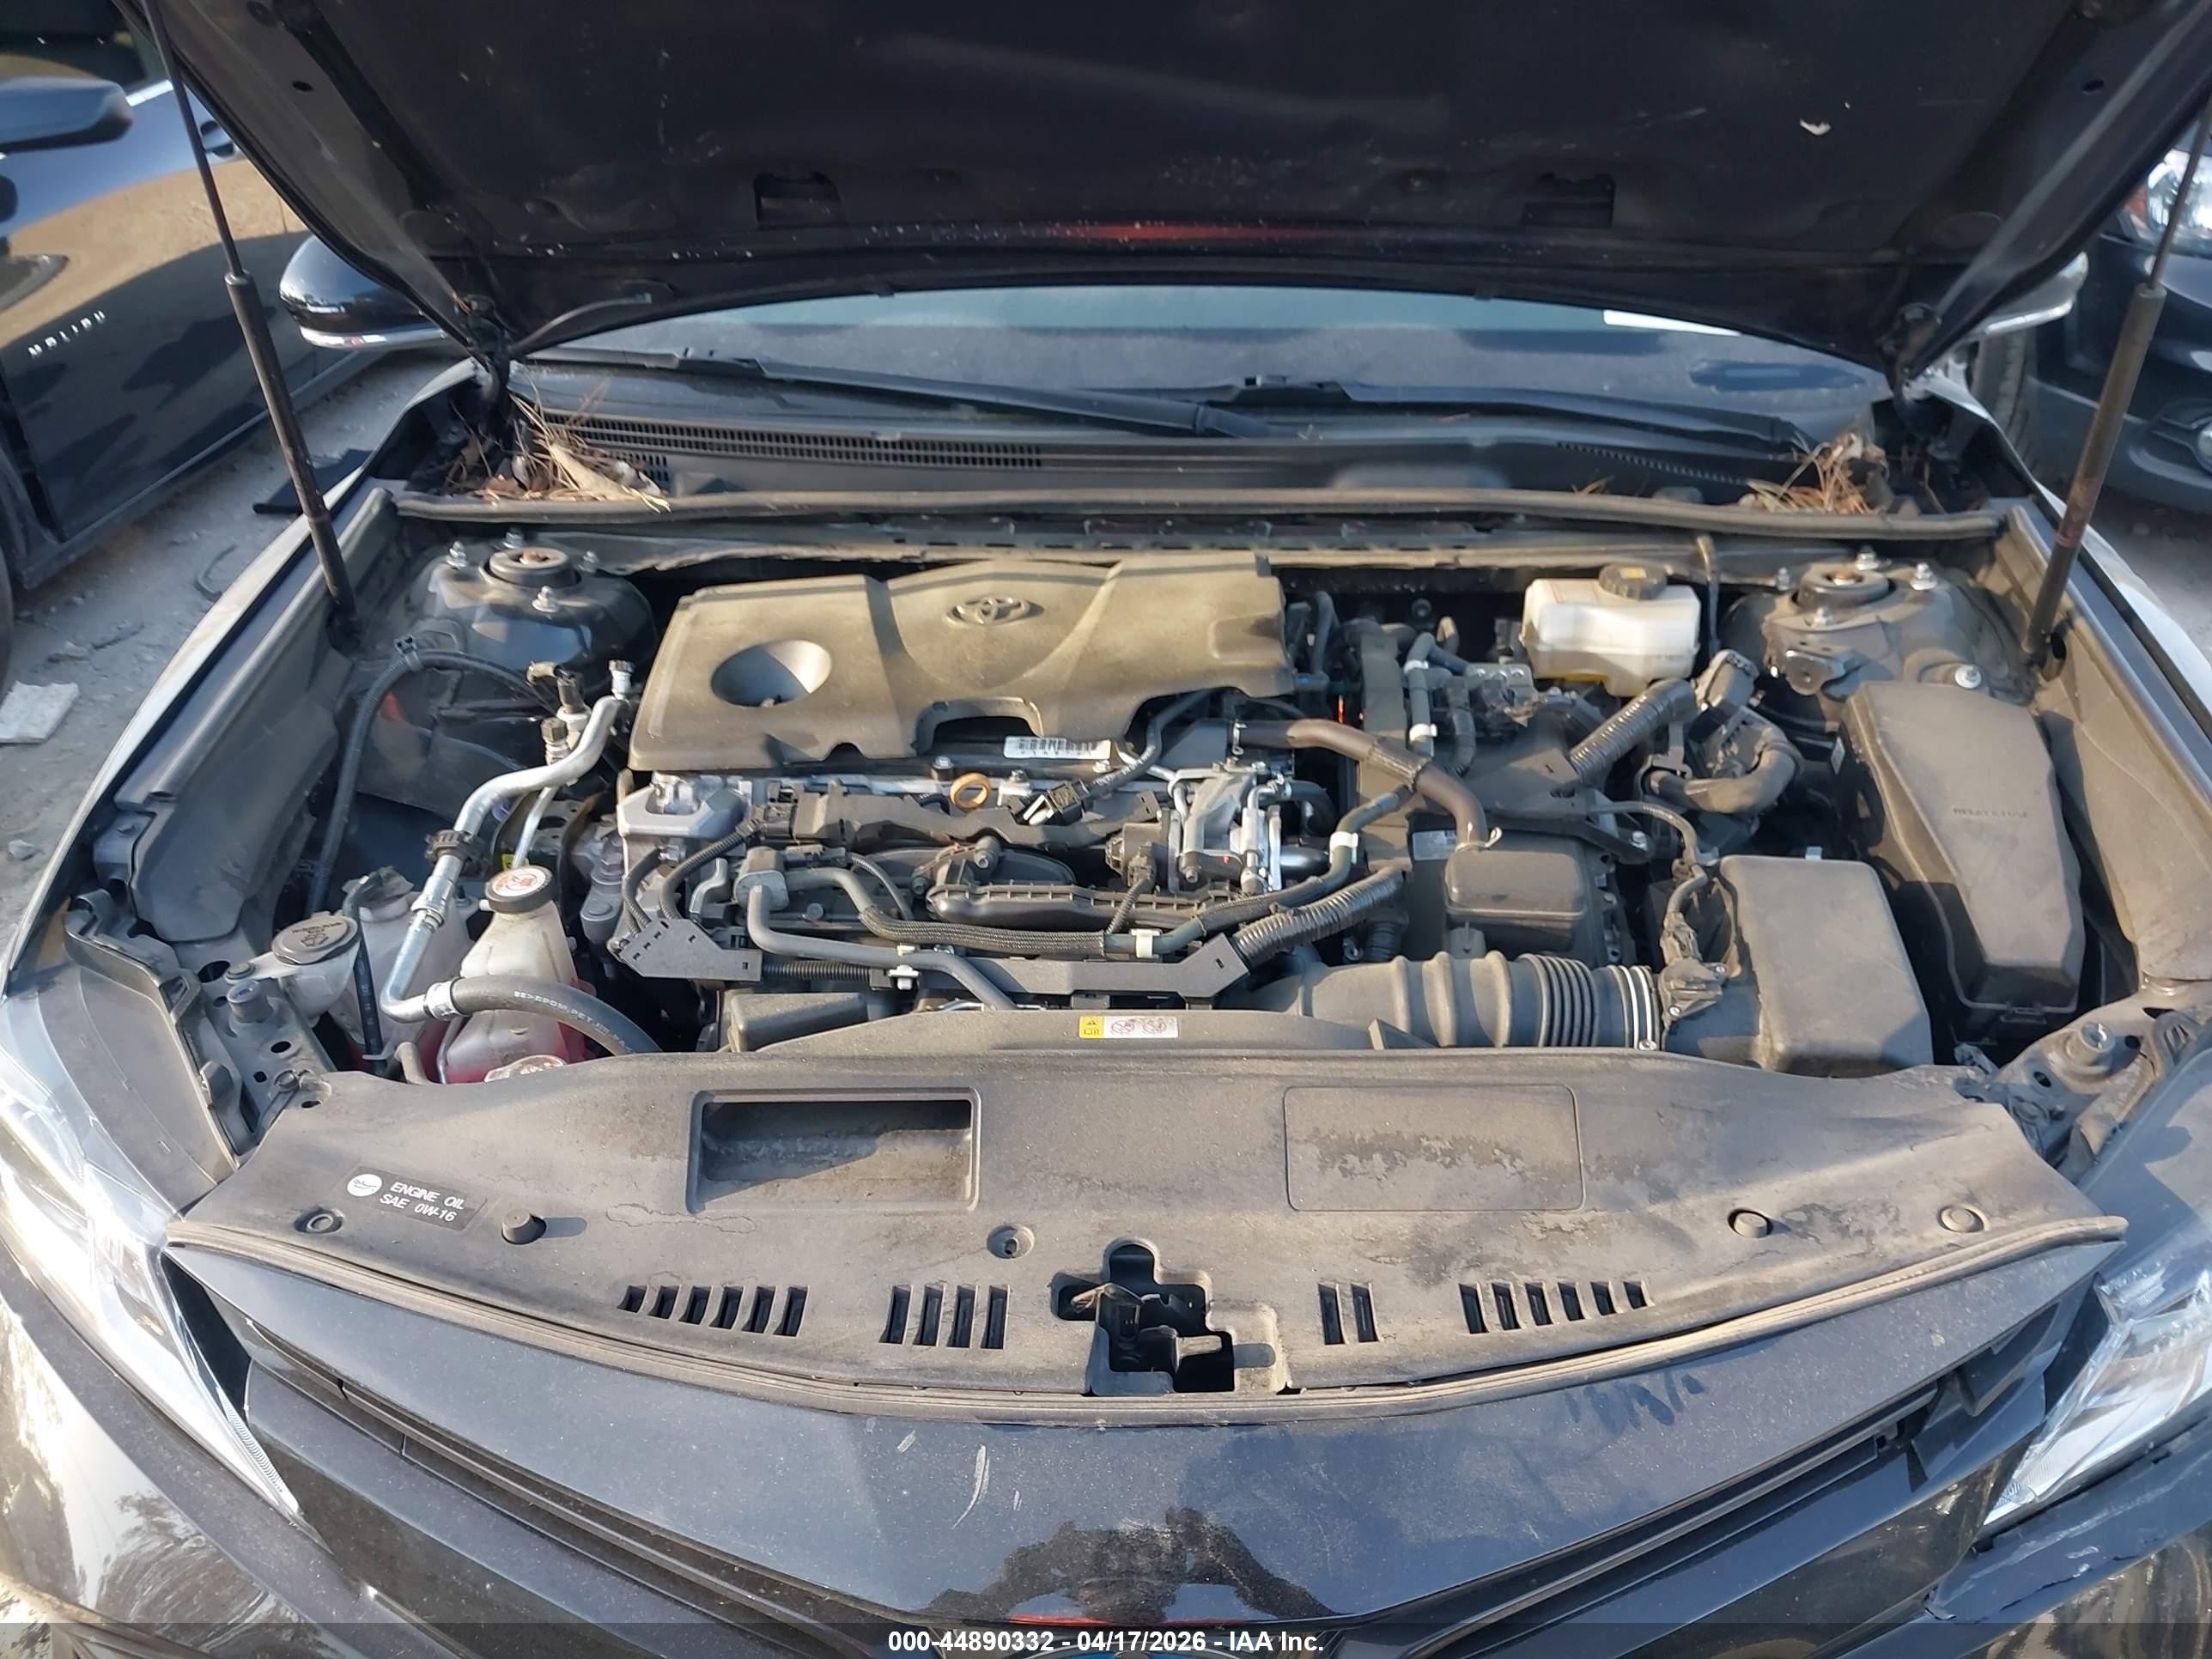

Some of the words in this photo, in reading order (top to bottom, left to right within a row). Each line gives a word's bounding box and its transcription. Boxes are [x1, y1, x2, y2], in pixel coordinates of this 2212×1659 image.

[380, 1194, 410, 1209] SAE
[415, 1204, 457, 1222] 0W-16
[391, 1182, 440, 1202] ENGINE
[444, 1196, 465, 1210] OIL
